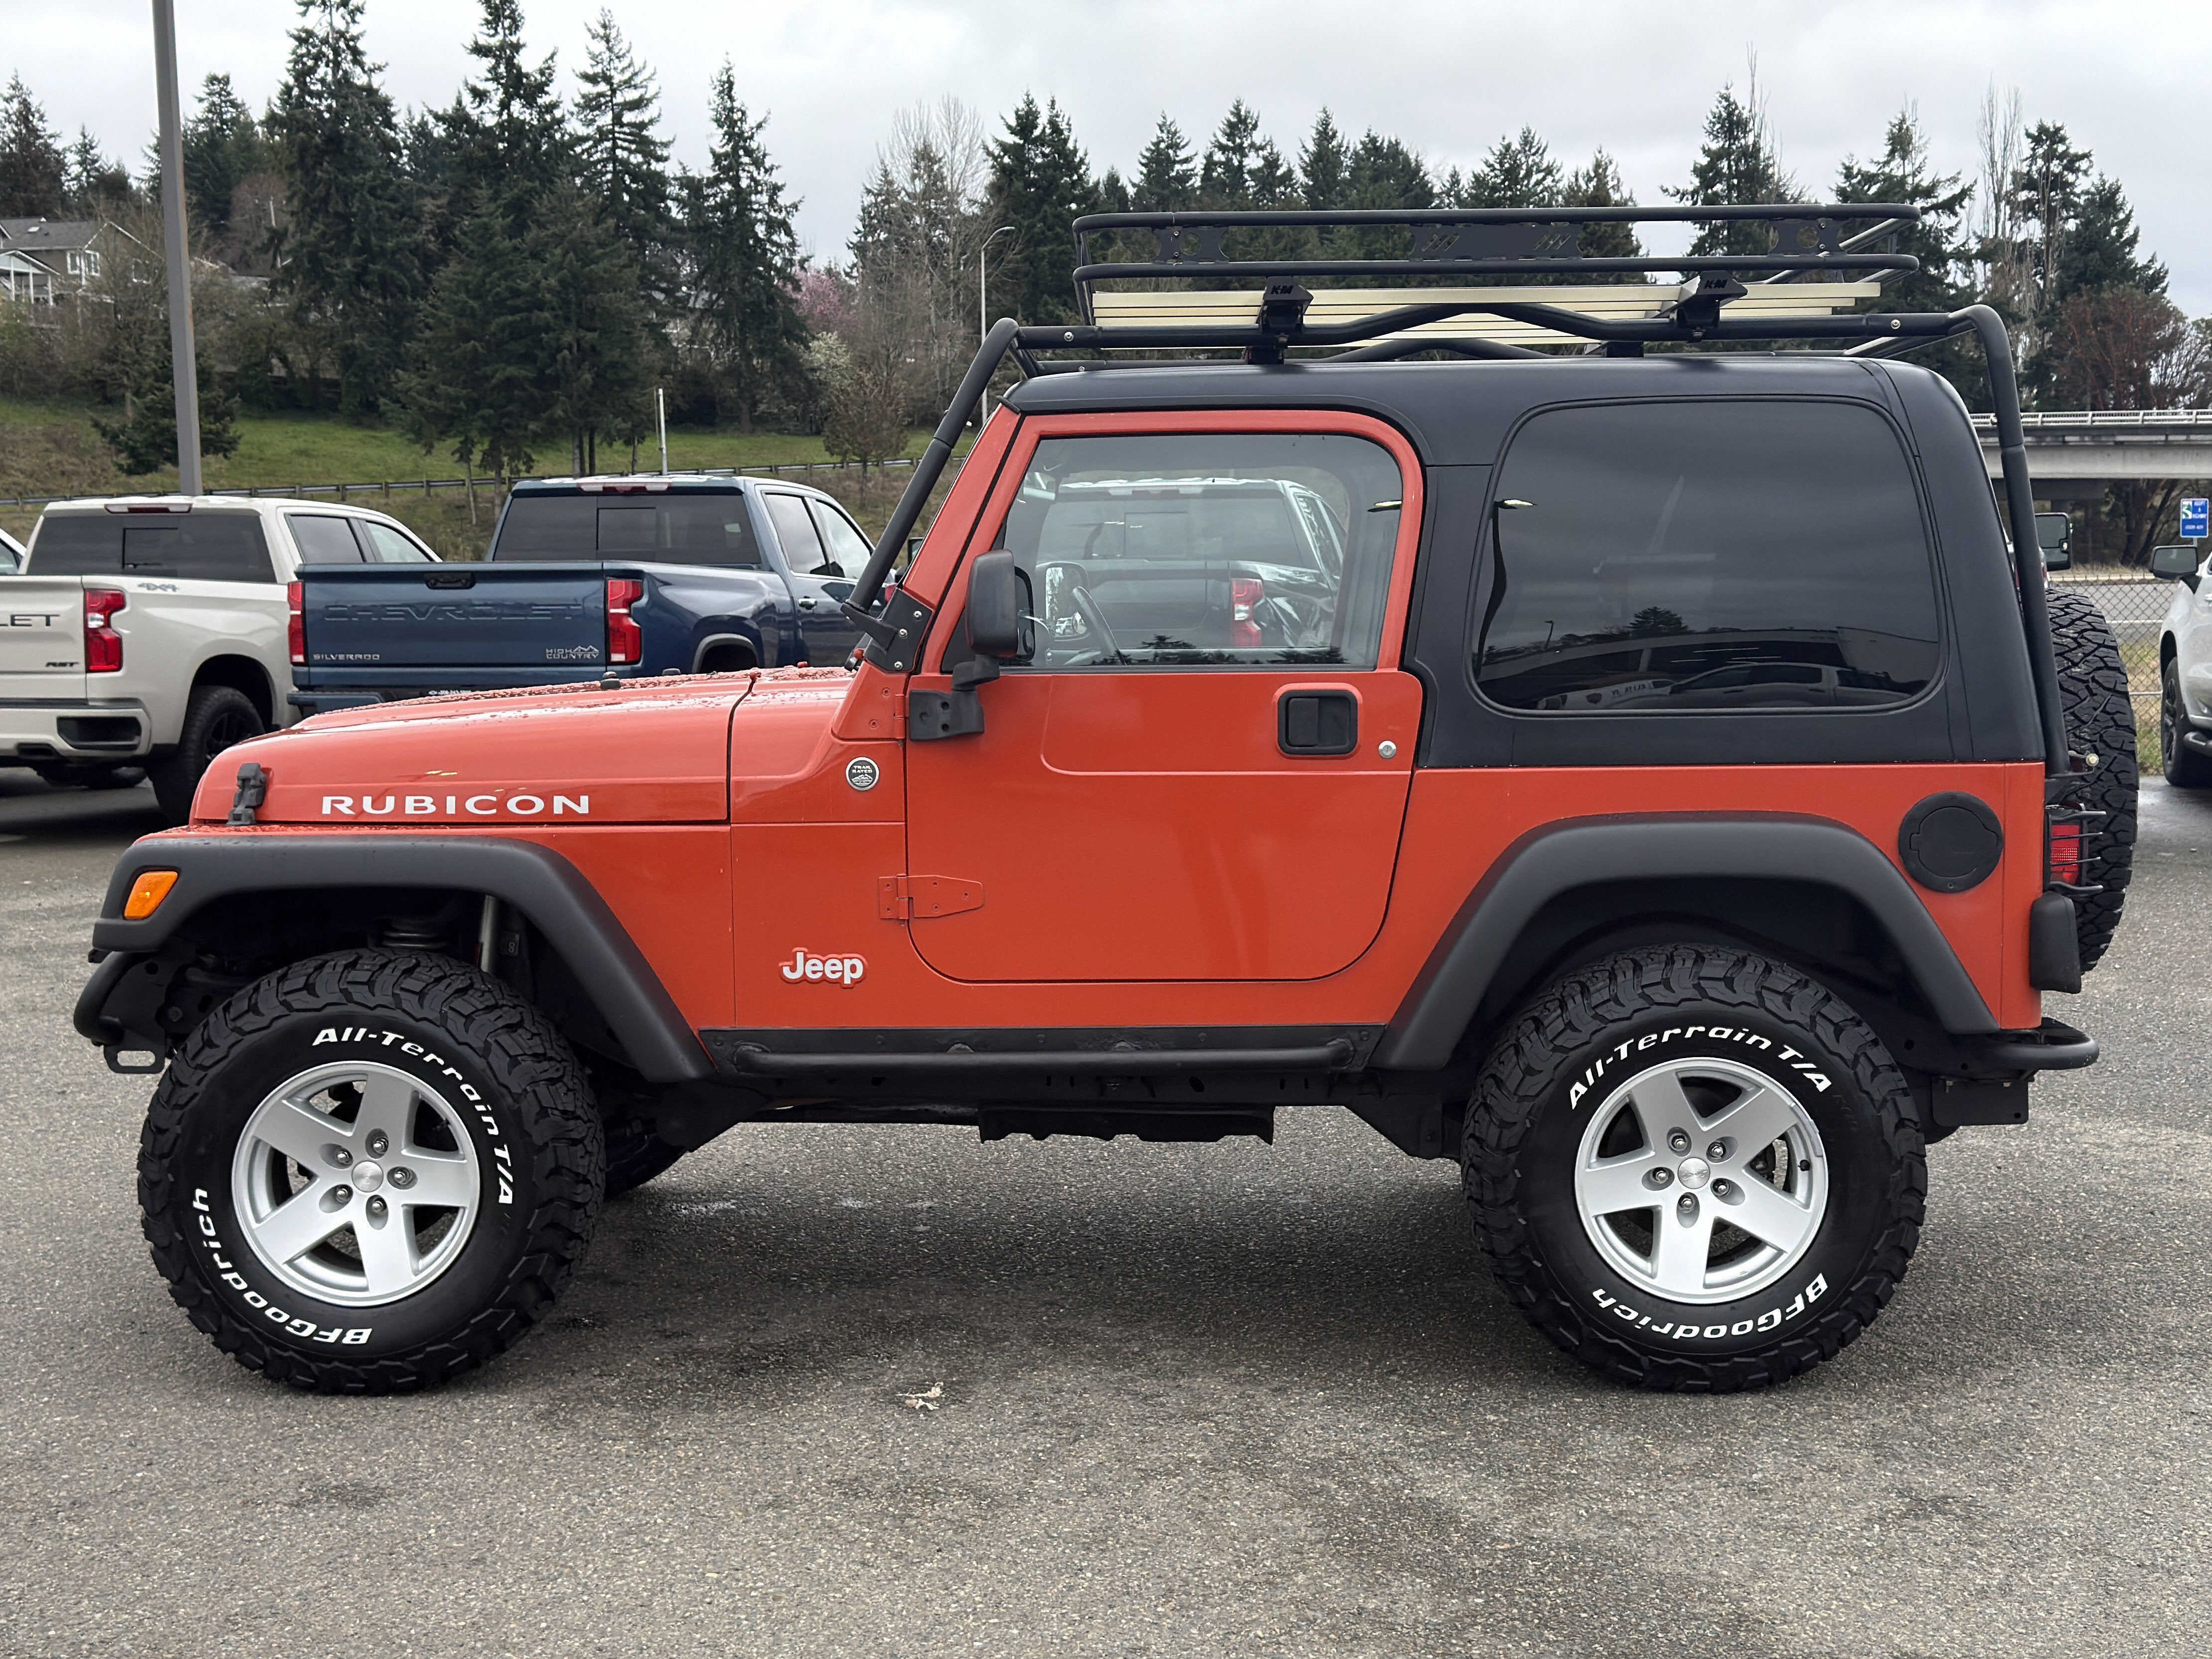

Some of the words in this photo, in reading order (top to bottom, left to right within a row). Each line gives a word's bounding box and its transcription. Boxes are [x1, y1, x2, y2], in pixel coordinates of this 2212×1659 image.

[321, 795, 589, 815] RUBICON
[783, 952, 863, 984] Jeep
[1570, 1026, 1772, 1109] All-Terrain
[1778, 1045, 1832, 1092] T/A
[312, 1027, 499, 1135] All-Terrain
[494, 1144, 513, 1204] T/A
[193, 1188, 373, 1345] BFGoodrich
[1593, 1273, 1828, 1340] BFGoodrich
